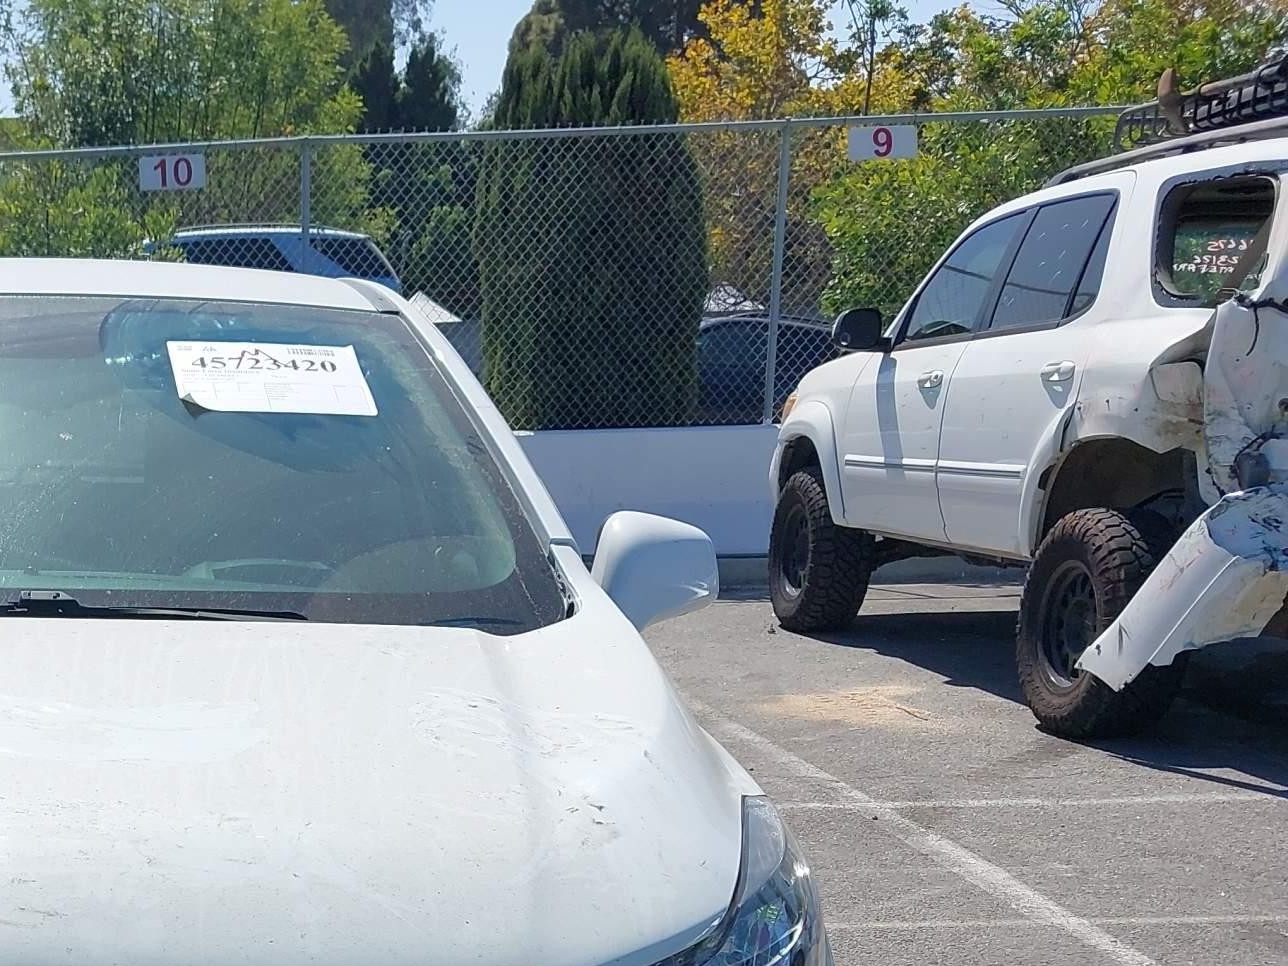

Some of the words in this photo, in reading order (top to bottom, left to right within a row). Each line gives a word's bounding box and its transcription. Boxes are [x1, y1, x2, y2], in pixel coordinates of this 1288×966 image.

[872, 127, 893, 157] 9
[153, 157, 193, 188] 10
[191, 356, 337, 373] 45723420
